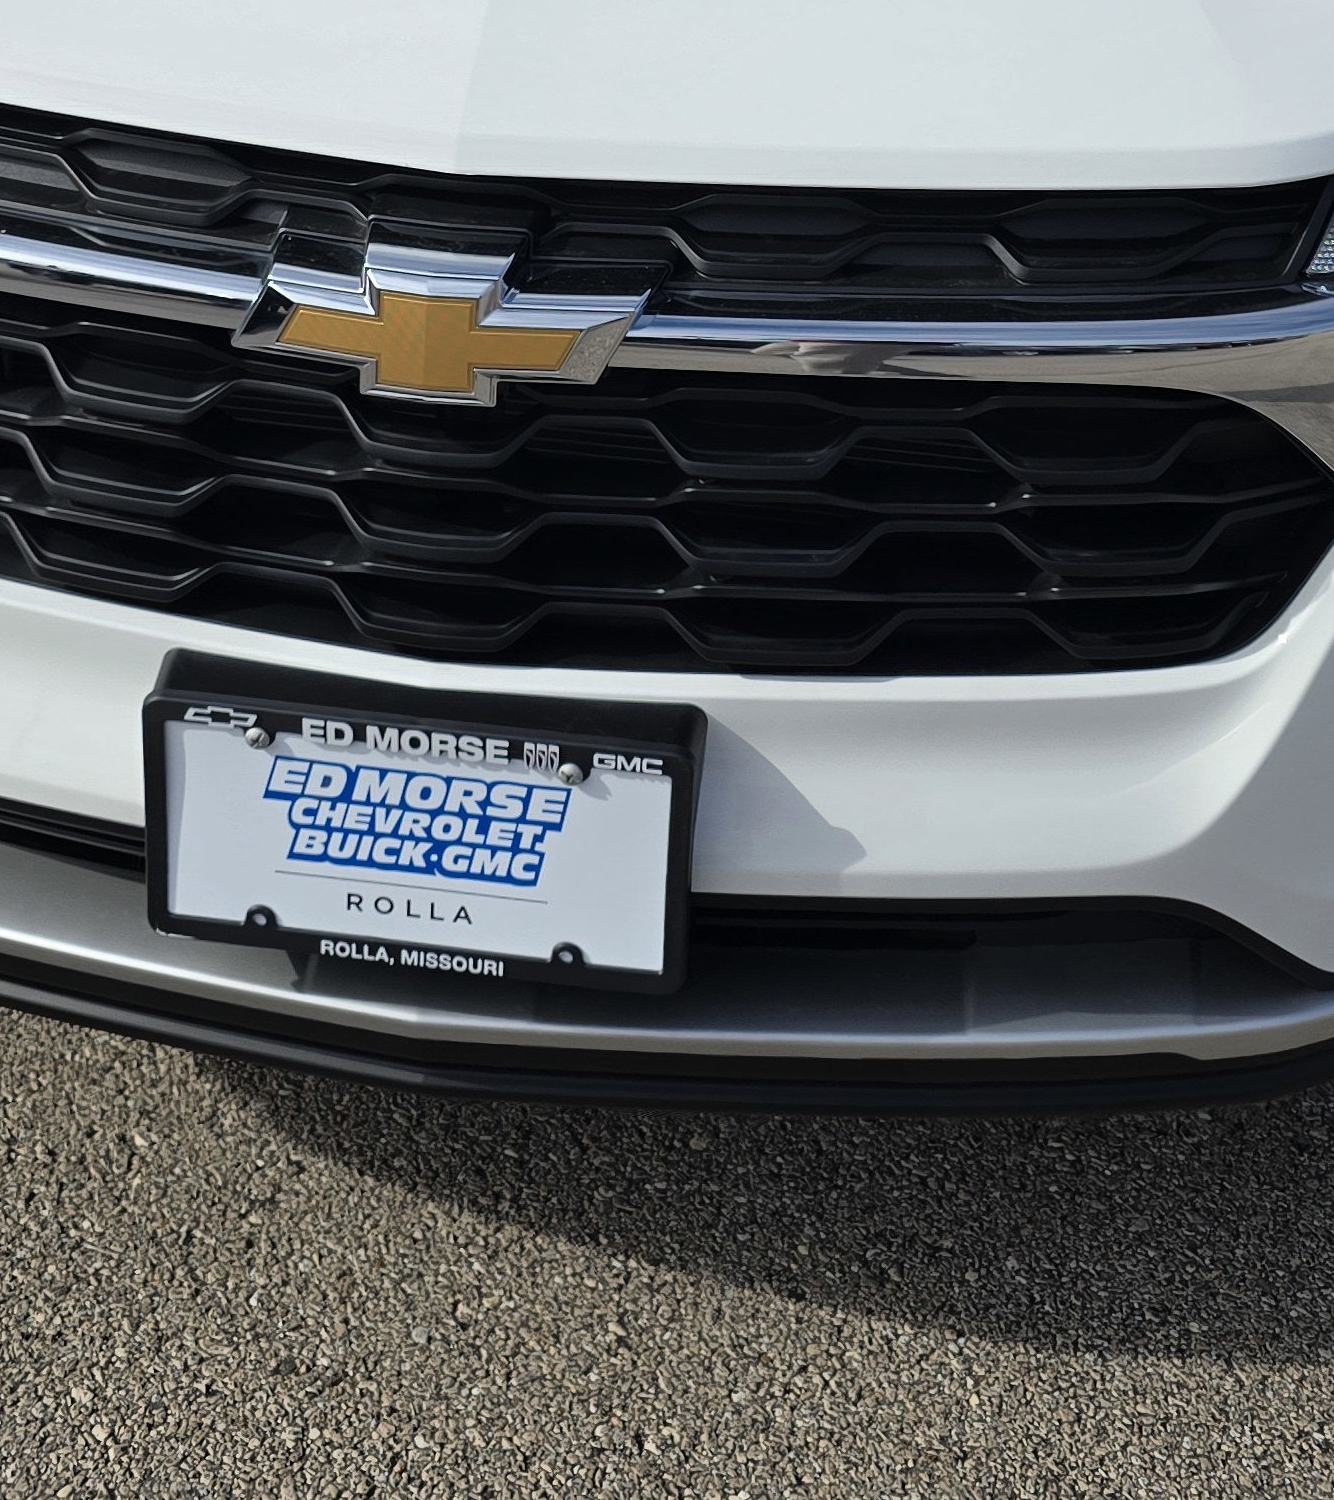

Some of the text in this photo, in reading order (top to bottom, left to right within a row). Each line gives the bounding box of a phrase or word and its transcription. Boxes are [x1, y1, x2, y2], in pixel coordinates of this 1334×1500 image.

[301, 717, 664, 775] ED MORSE GMC
[269, 759, 568, 822] ED MORSE
[347, 893, 473, 925] ROLLA
[320, 939, 505, 977] ROLLA, MISSOURI
